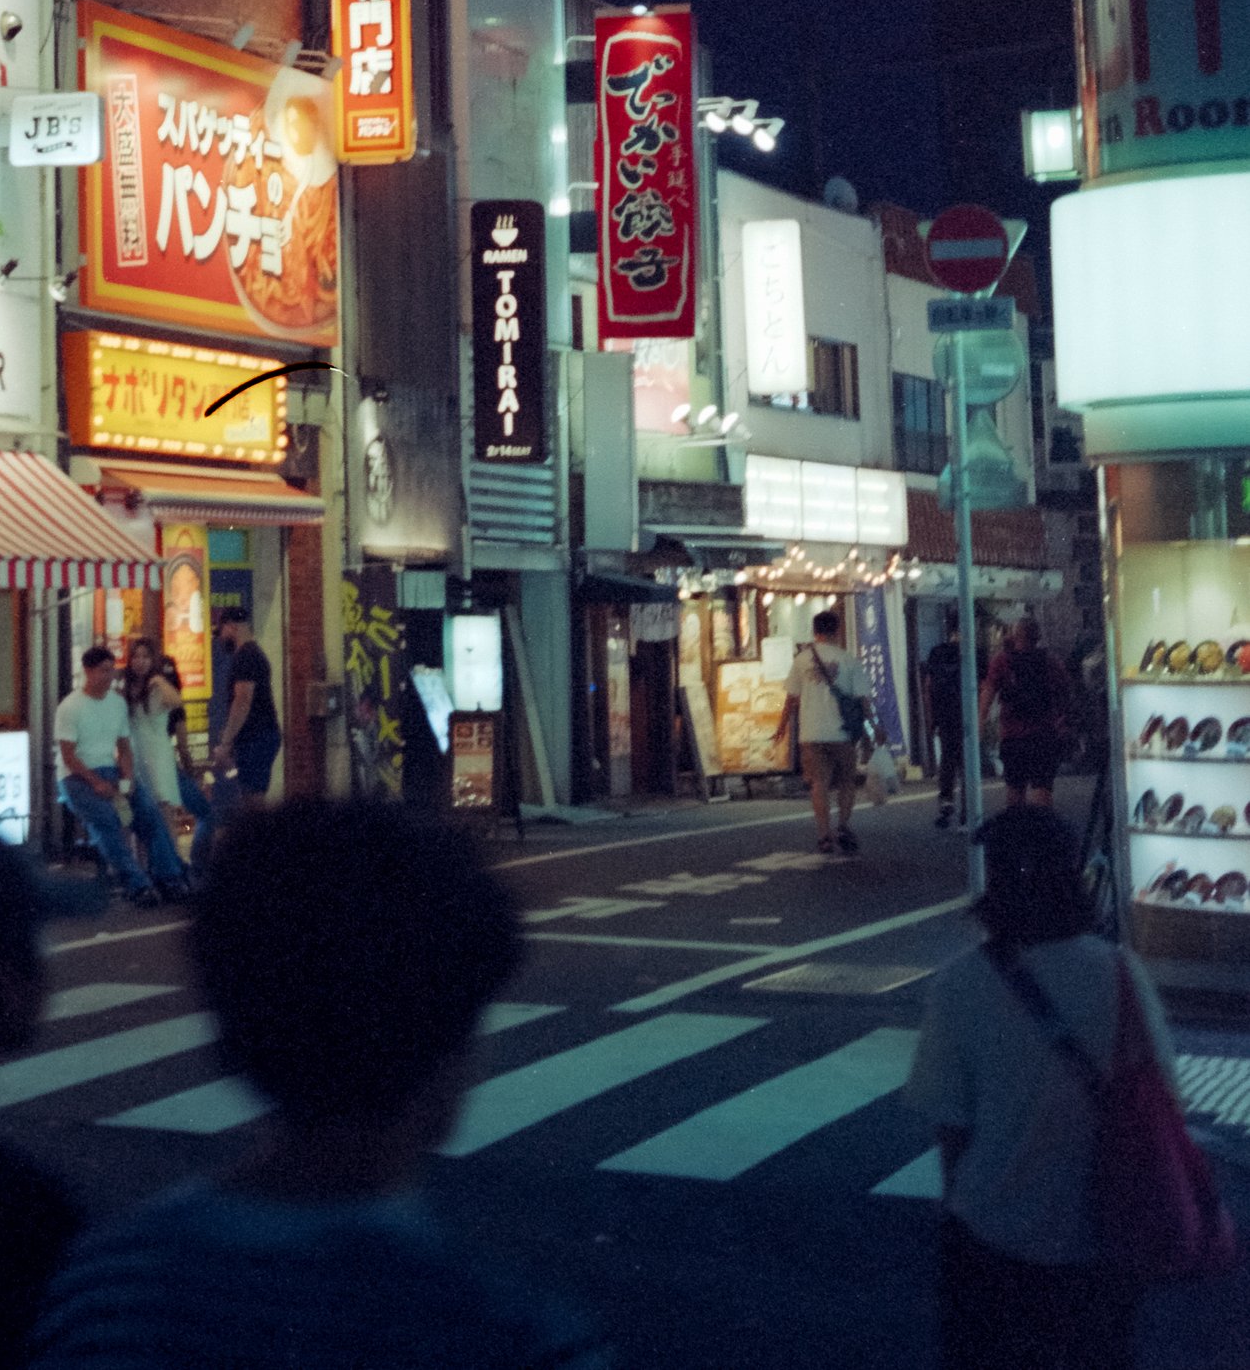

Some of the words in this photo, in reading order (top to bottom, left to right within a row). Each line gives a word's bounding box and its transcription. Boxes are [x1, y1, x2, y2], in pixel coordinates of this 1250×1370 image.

[25, 116, 82, 139] JB'S
[157, 93, 284, 170] スパゲッティー
[156, 162, 283, 277] パンチョ
[483, 249, 528, 264] RAMEN
[494, 270, 520, 436] TOMIRAI
